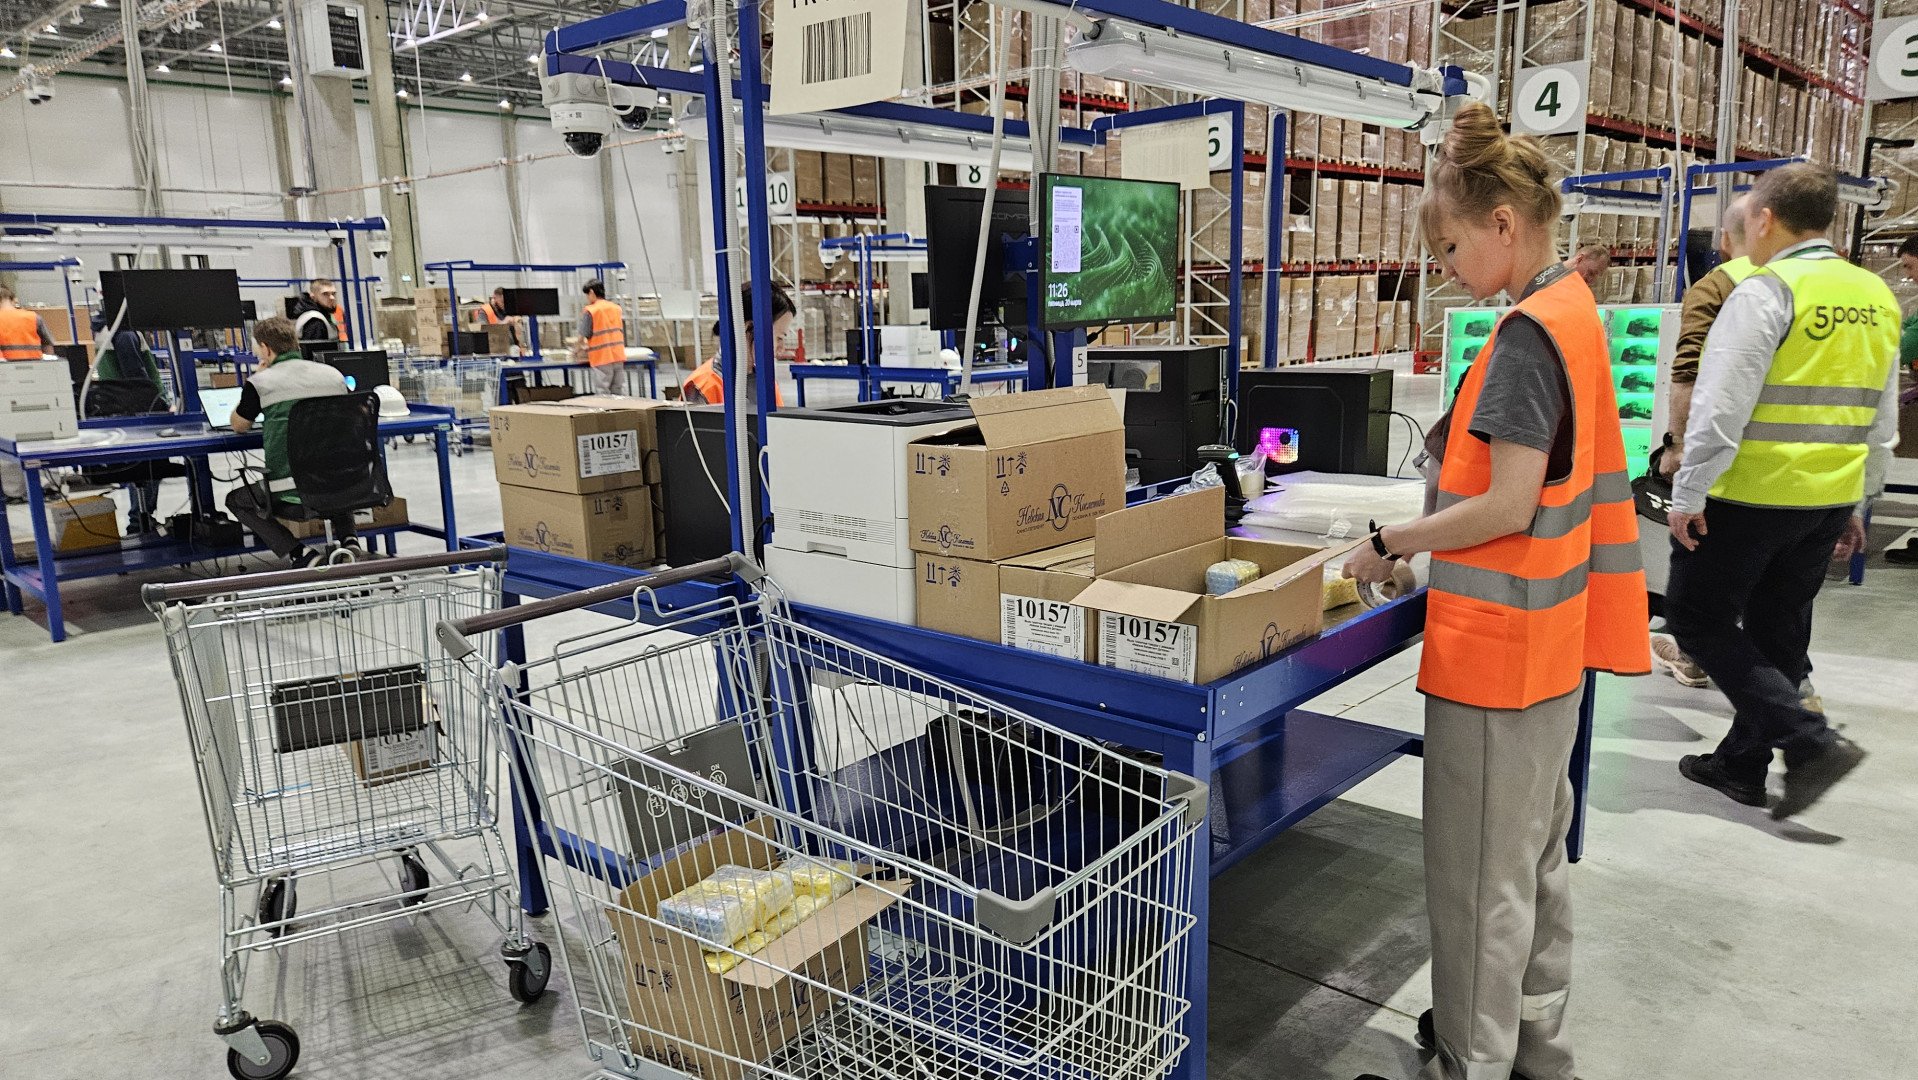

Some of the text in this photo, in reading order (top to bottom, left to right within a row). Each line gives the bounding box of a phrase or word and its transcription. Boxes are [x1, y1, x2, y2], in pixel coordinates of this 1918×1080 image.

[1901, 34, 1918, 77] 3
[1534, 80, 1562, 117] 4
[1208, 126, 1221, 157] 6
[769, 182, 788, 205] 10
[1048, 282, 1068, 298] 11:26
[1804, 304, 1878, 341] 5post
[1077, 352, 1084, 368] 5
[590, 433, 628, 451] 10157
[1016, 598, 1070, 624] 10157
[1117, 616, 1181, 645] 10157
